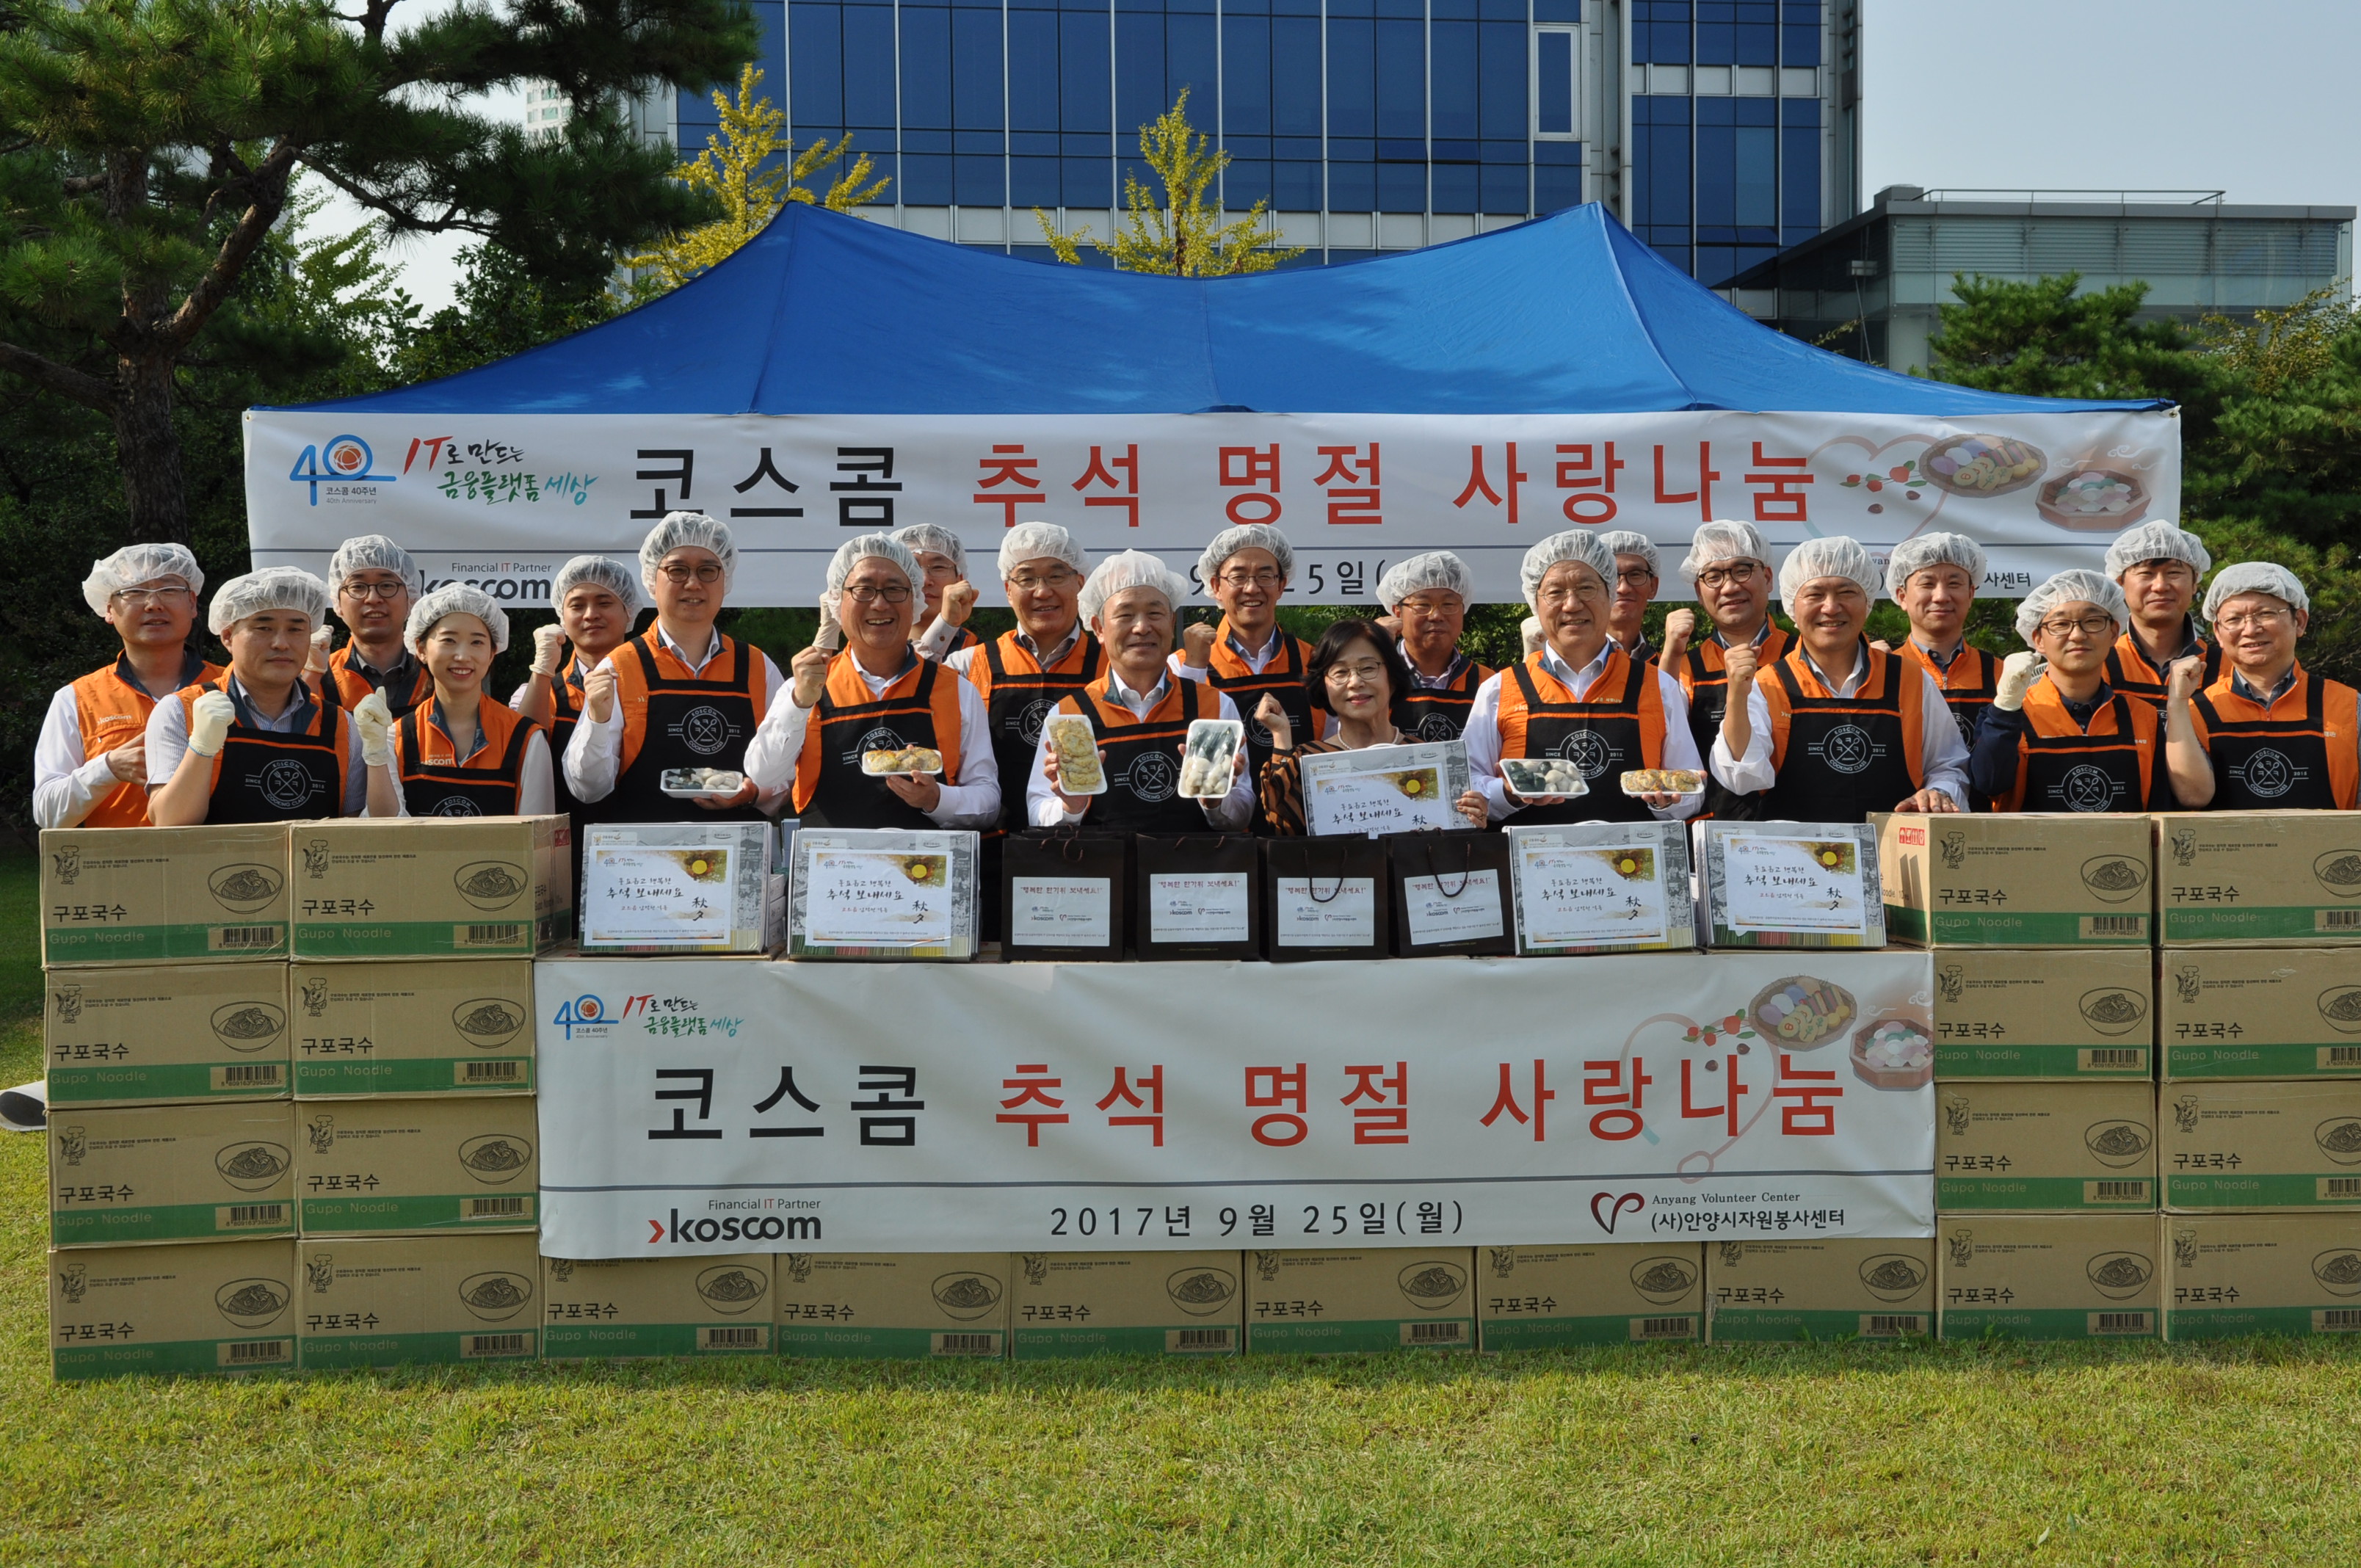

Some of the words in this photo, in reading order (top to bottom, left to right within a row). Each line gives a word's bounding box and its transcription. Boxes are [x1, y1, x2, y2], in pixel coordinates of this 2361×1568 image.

[352, 487, 376, 495] 40주년
[436, 471, 541, 506] 금융플랫폼
[543, 473, 598, 507] 세상
[630, 448, 903, 527] 코스콤
[973, 443, 1139, 528] 추석
[1218, 441, 1383, 526] 명절
[1452, 440, 1815, 525] 사랑나눔
[451, 562, 498, 572] Financial
[501, 563, 510, 572] IT
[513, 563, 551, 572] Partner
[1332, 813, 1354, 824] 추석
[1359, 807, 1403, 821] 보내세요
[1744, 874, 1767, 886] 추석
[1772, 874, 1818, 886] 보내세요
[606, 888, 630, 899] 추석
[636, 888, 683, 898] 보내세요
[827, 889, 849, 900] 추석
[856, 889, 904, 901] 보내세요
[1541, 888, 1564, 901] 추석
[1570, 887, 1617, 899] 보내세요
[1938, 889, 2008, 906] 구포국수
[2171, 885, 2240, 903] 구포국수
[52, 904, 128, 923] 구포국수
[302, 899, 375, 916] 구포국수
[1934, 916, 1970, 928] Gupo
[1978, 917, 2023, 927] Noodle
[2169, 912, 2204, 923] Gupo
[2212, 912, 2257, 923] Noodle
[49, 933, 87, 945] Gupo
[94, 929, 145, 943] Noodle
[298, 928, 335, 940] Gupo
[343, 928, 391, 938] Noodle
[643, 1015, 708, 1038] 금융플랫폼
[710, 1017, 744, 1038] 세상
[1937, 1022, 2006, 1039] 구포국수
[2175, 1022, 2244, 1039] 구포국수
[54, 1042, 130, 1062] 구포국수
[300, 1037, 374, 1056] 구포국수
[1935, 1050, 1968, 1061] Gupo
[1976, 1050, 2020, 1060] Noodle
[2172, 1050, 2206, 1061] Gupo
[2213, 1050, 2259, 1060] Noodle
[50, 1072, 89, 1085] Gupo
[95, 1070, 147, 1083] Noodle
[299, 1066, 336, 1077] Gupo
[344, 1065, 392, 1075] Noodle
[648, 1065, 925, 1147] 코스콤
[995, 1064, 1164, 1148] 추석
[1244, 1061, 1410, 1147] 명절
[1479, 1053, 1843, 1142] 사랑나눔
[1944, 1155, 2012, 1172] 구포국수
[2173, 1153, 2242, 1170] 구포국수
[307, 1173, 380, 1192] 구포국수
[1942, 1183, 1975, 1193] Gupo
[1982, 1183, 2026, 1193] Noodle
[2172, 1180, 2207, 1191] Gupo
[2214, 1180, 2260, 1190] Noodle
[58, 1184, 134, 1204] 구포국수
[1652, 1194, 1697, 1206] Anyang
[1702, 1192, 1757, 1204] Volunteer
[1761, 1191, 1800, 1202] Center
[305, 1203, 342, 1215] Gupo
[350, 1202, 398, 1213] Noodle
[708, 1199, 761, 1210] Financial
[764, 1199, 775, 1210] IT
[777, 1199, 821, 1210] Partner
[55, 1214, 95, 1227] Gupo
[102, 1213, 152, 1224] Noodle
[670, 1208, 822, 1244] koscom
[1050, 1205, 1192, 1238] 2017년
[1219, 1203, 1277, 1237] 9월
[1302, 1200, 1463, 1235] 25일(월)
[1650, 1209, 1844, 1233] (사)안양시자원봉사센터
[1716, 1288, 1785, 1304] 구포국수
[1948, 1287, 2015, 1304] 구포국수
[2174, 1286, 2240, 1304] 구포국수
[547, 1302, 619, 1320] 구포국수
[784, 1304, 855, 1321] 구포국수
[1021, 1304, 1091, 1322] 구포국수
[1254, 1300, 1324, 1318] 구포국수
[1489, 1296, 1557, 1314] 구포국수
[305, 1312, 380, 1332] 구포국수
[59, 1321, 134, 1343] 구포국수
[545, 1329, 582, 1342] Gupo
[589, 1329, 636, 1340] Noodle
[58, 1351, 96, 1364] Gupo
[104, 1348, 154, 1362] Noodle
